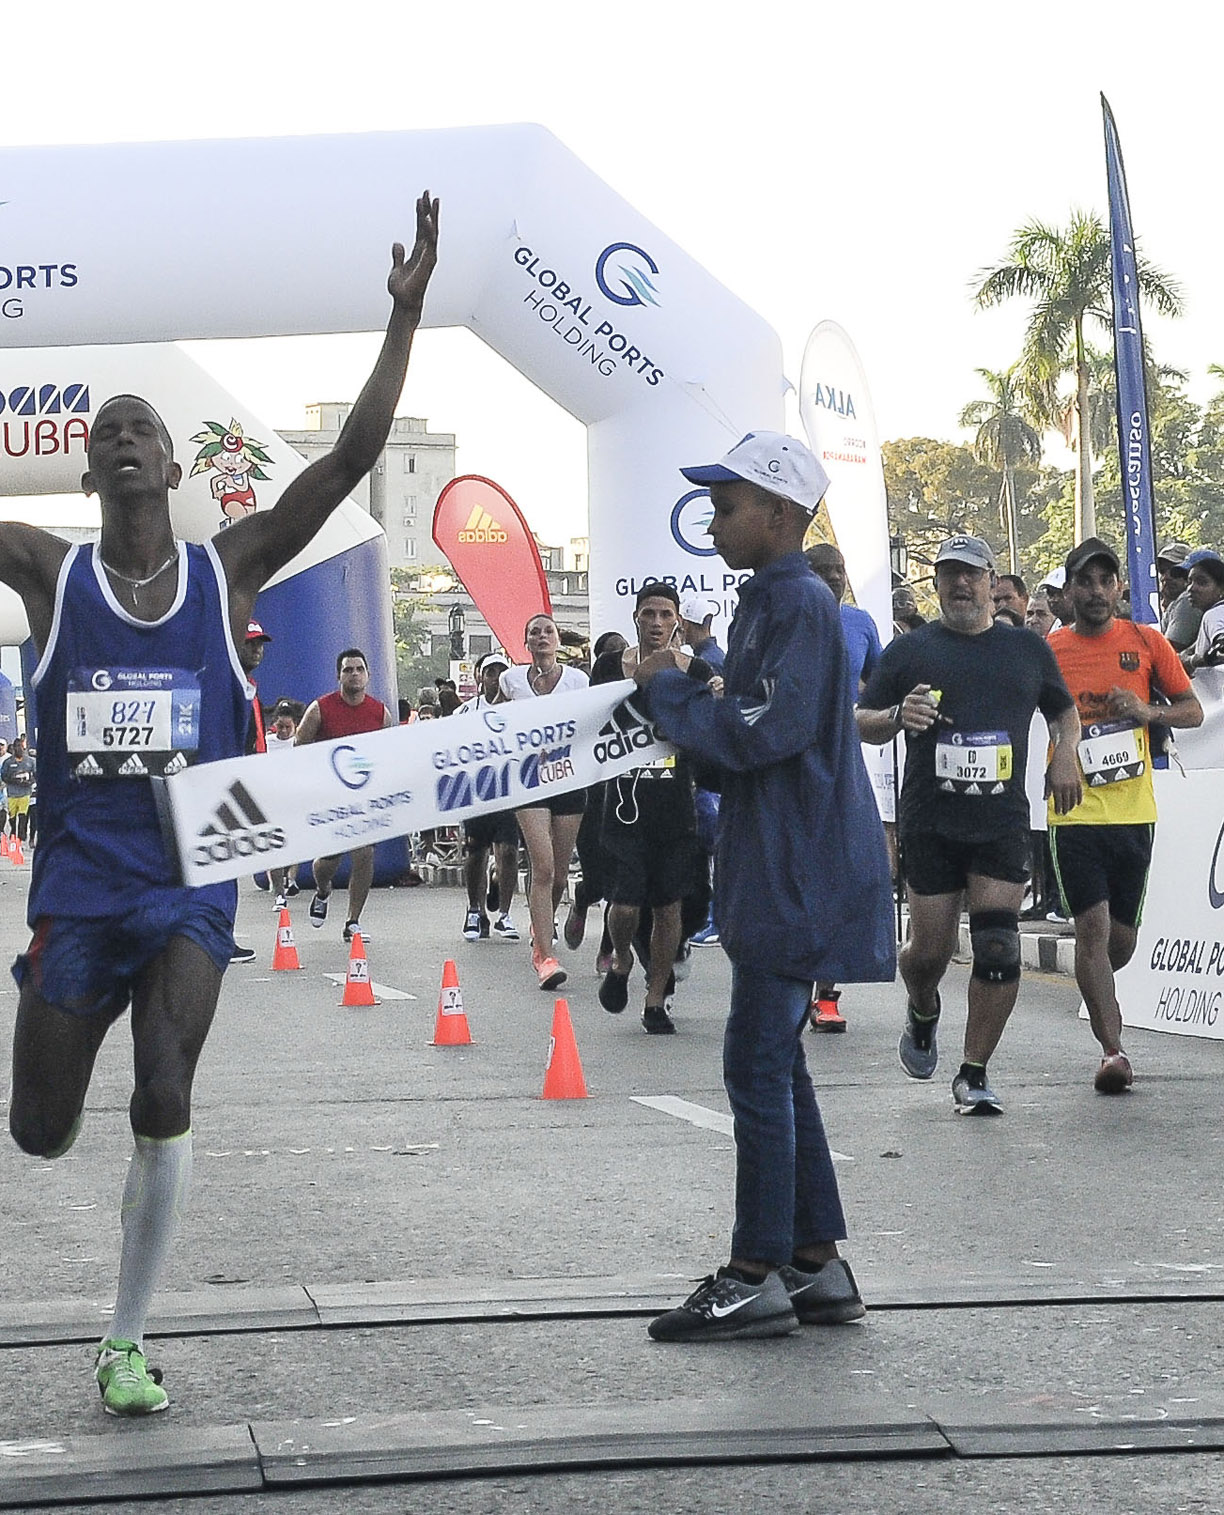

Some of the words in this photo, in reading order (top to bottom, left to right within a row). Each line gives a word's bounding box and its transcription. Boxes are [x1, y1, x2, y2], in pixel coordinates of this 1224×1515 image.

[514, 247, 593, 326] GLOBAL
[594, 320, 665, 386] PORTS
[523, 289, 617, 377] HOLDING
[616, 575, 713, 596] GLOBAL
[102, 726, 154, 747] 5727
[432, 737, 513, 770] GLOBAL
[516, 720, 577, 751] PORTS
[539, 758, 575, 785] CUBA
[956, 766, 987, 779] 3072
[1151, 937, 1206, 974] GLOBAL
[1154, 986, 1222, 1027] HOLDING
